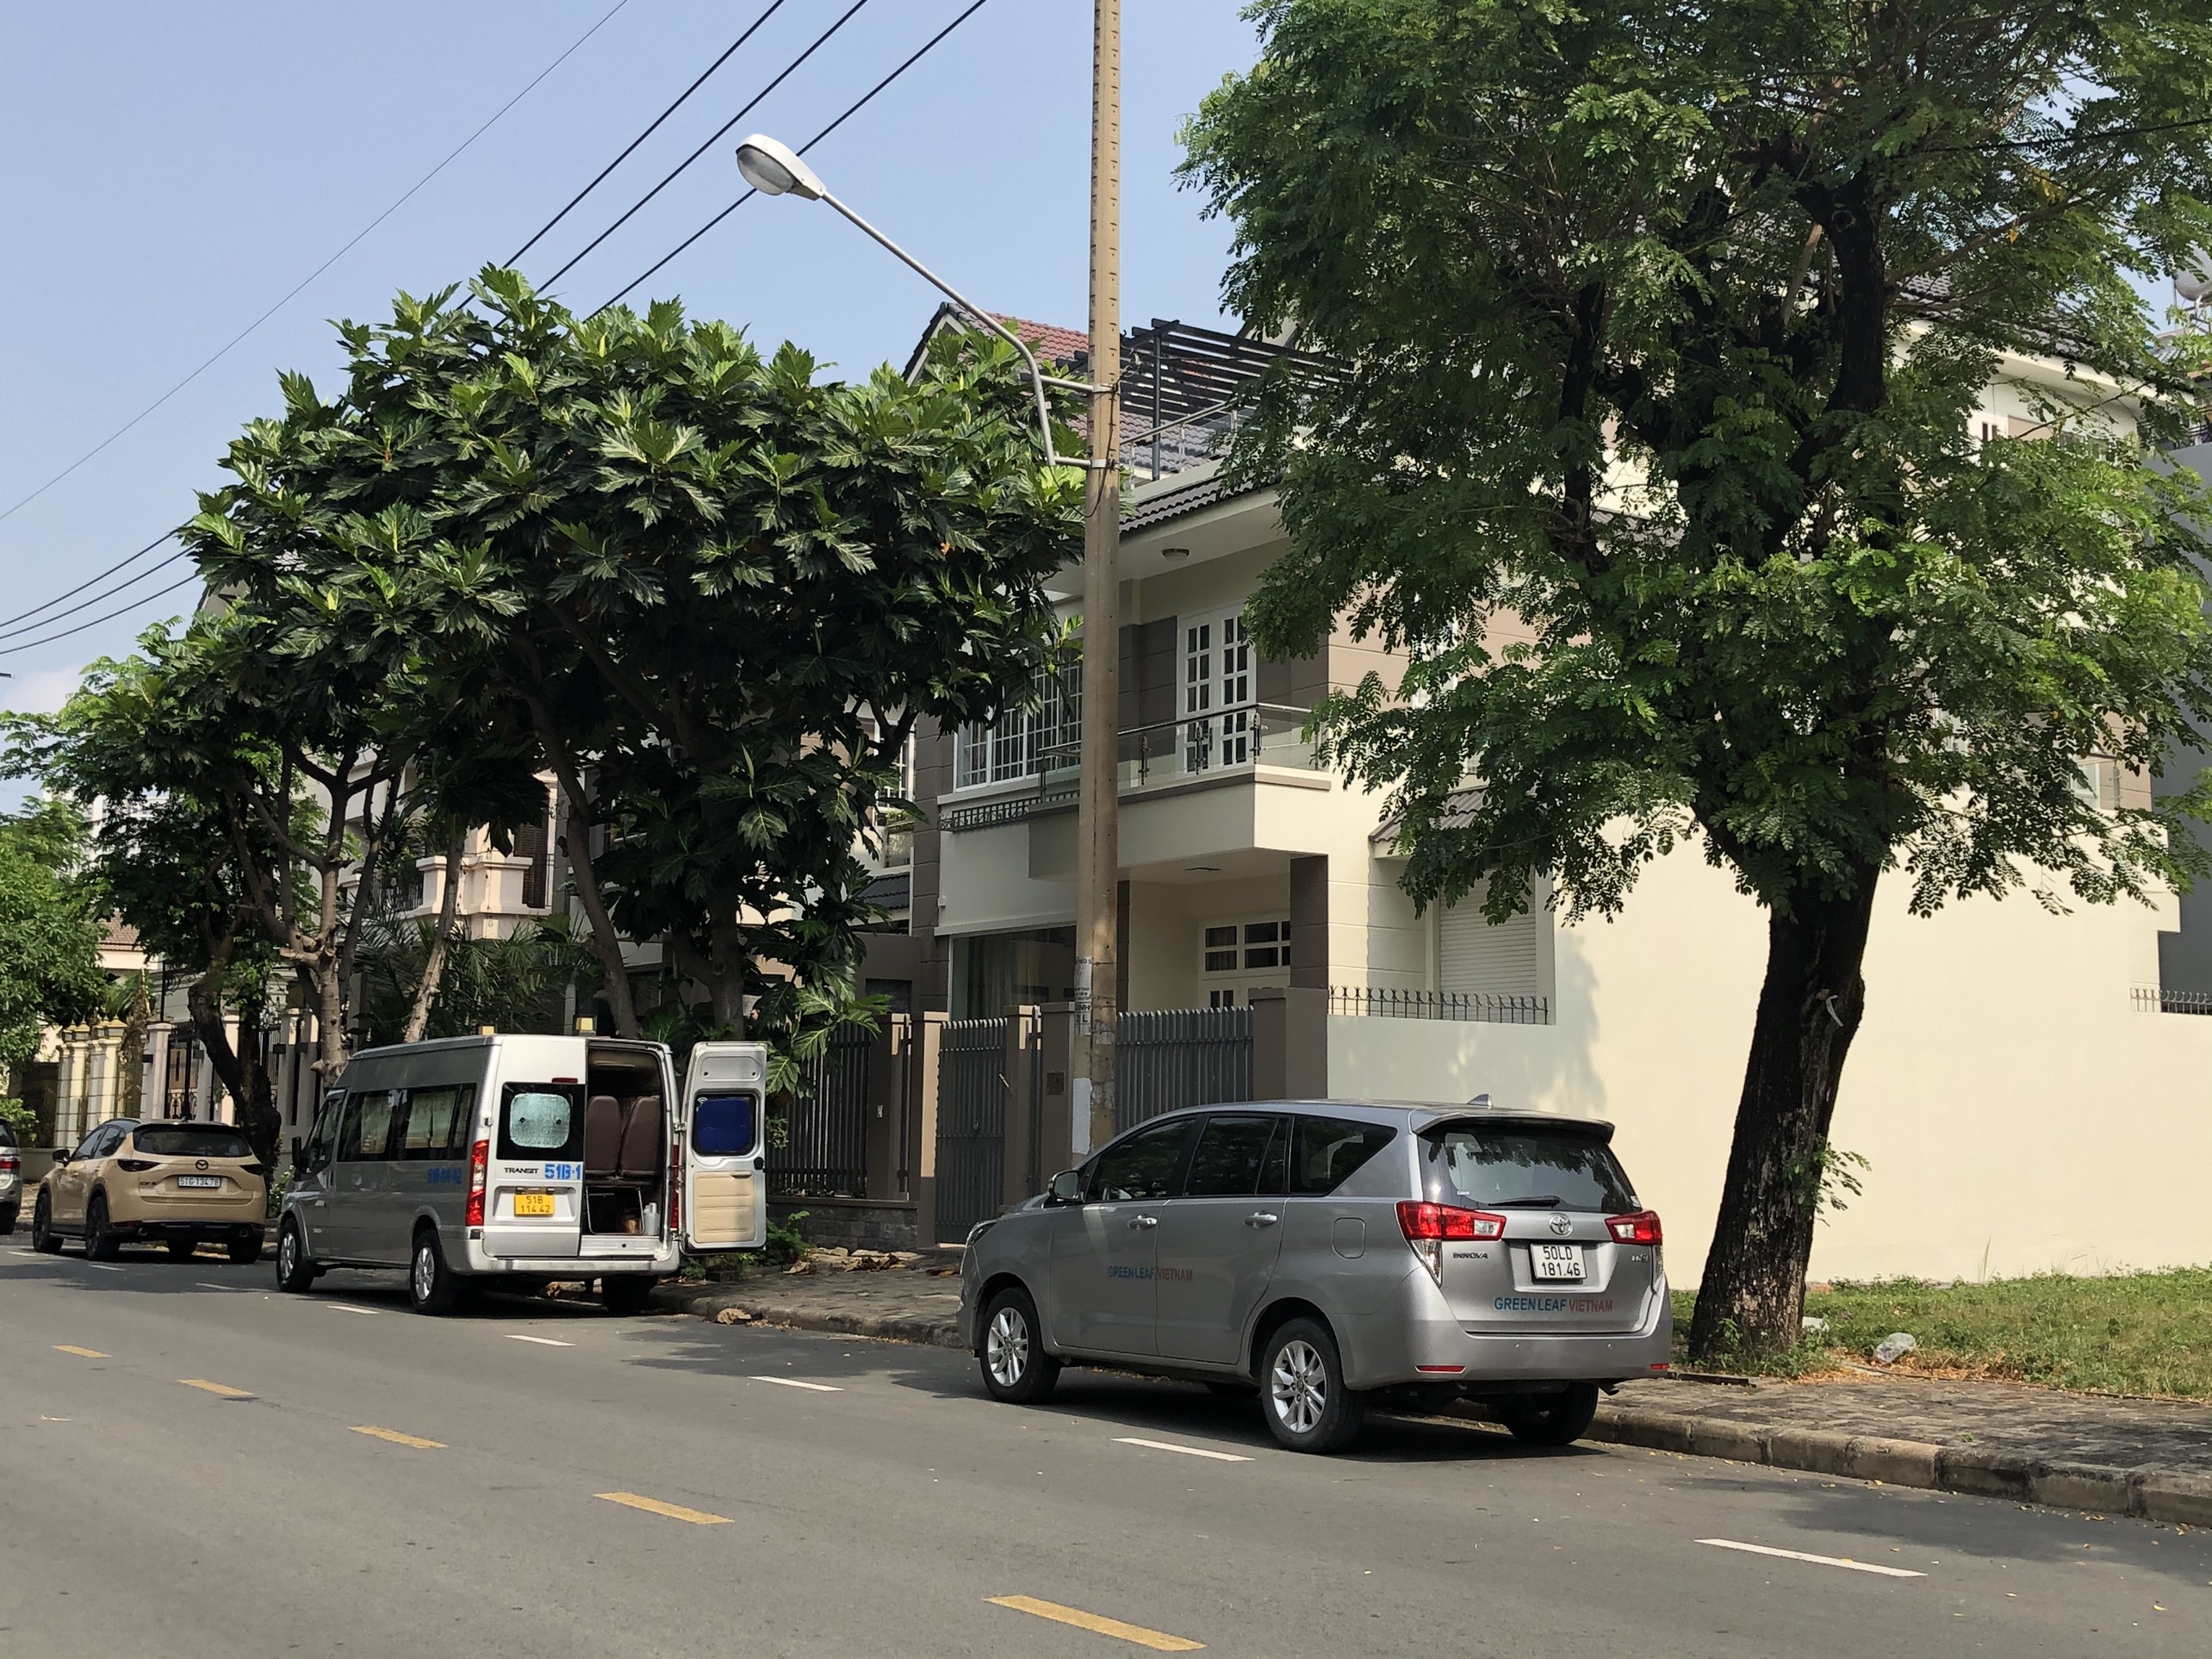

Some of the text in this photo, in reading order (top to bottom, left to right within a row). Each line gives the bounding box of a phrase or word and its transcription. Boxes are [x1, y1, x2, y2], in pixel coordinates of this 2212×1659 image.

[526, 1196, 543, 1204] 51B
[520, 1204, 550, 1214] 114.42
[1543, 1246, 1573, 1260] 50LD
[1108, 1265, 1193, 1282] GREEN LEAF VIETNAM
[1542, 1262, 1581, 1277] 181.46
[1494, 1296, 1613, 1313] GREEN LEAF VIETNAM
